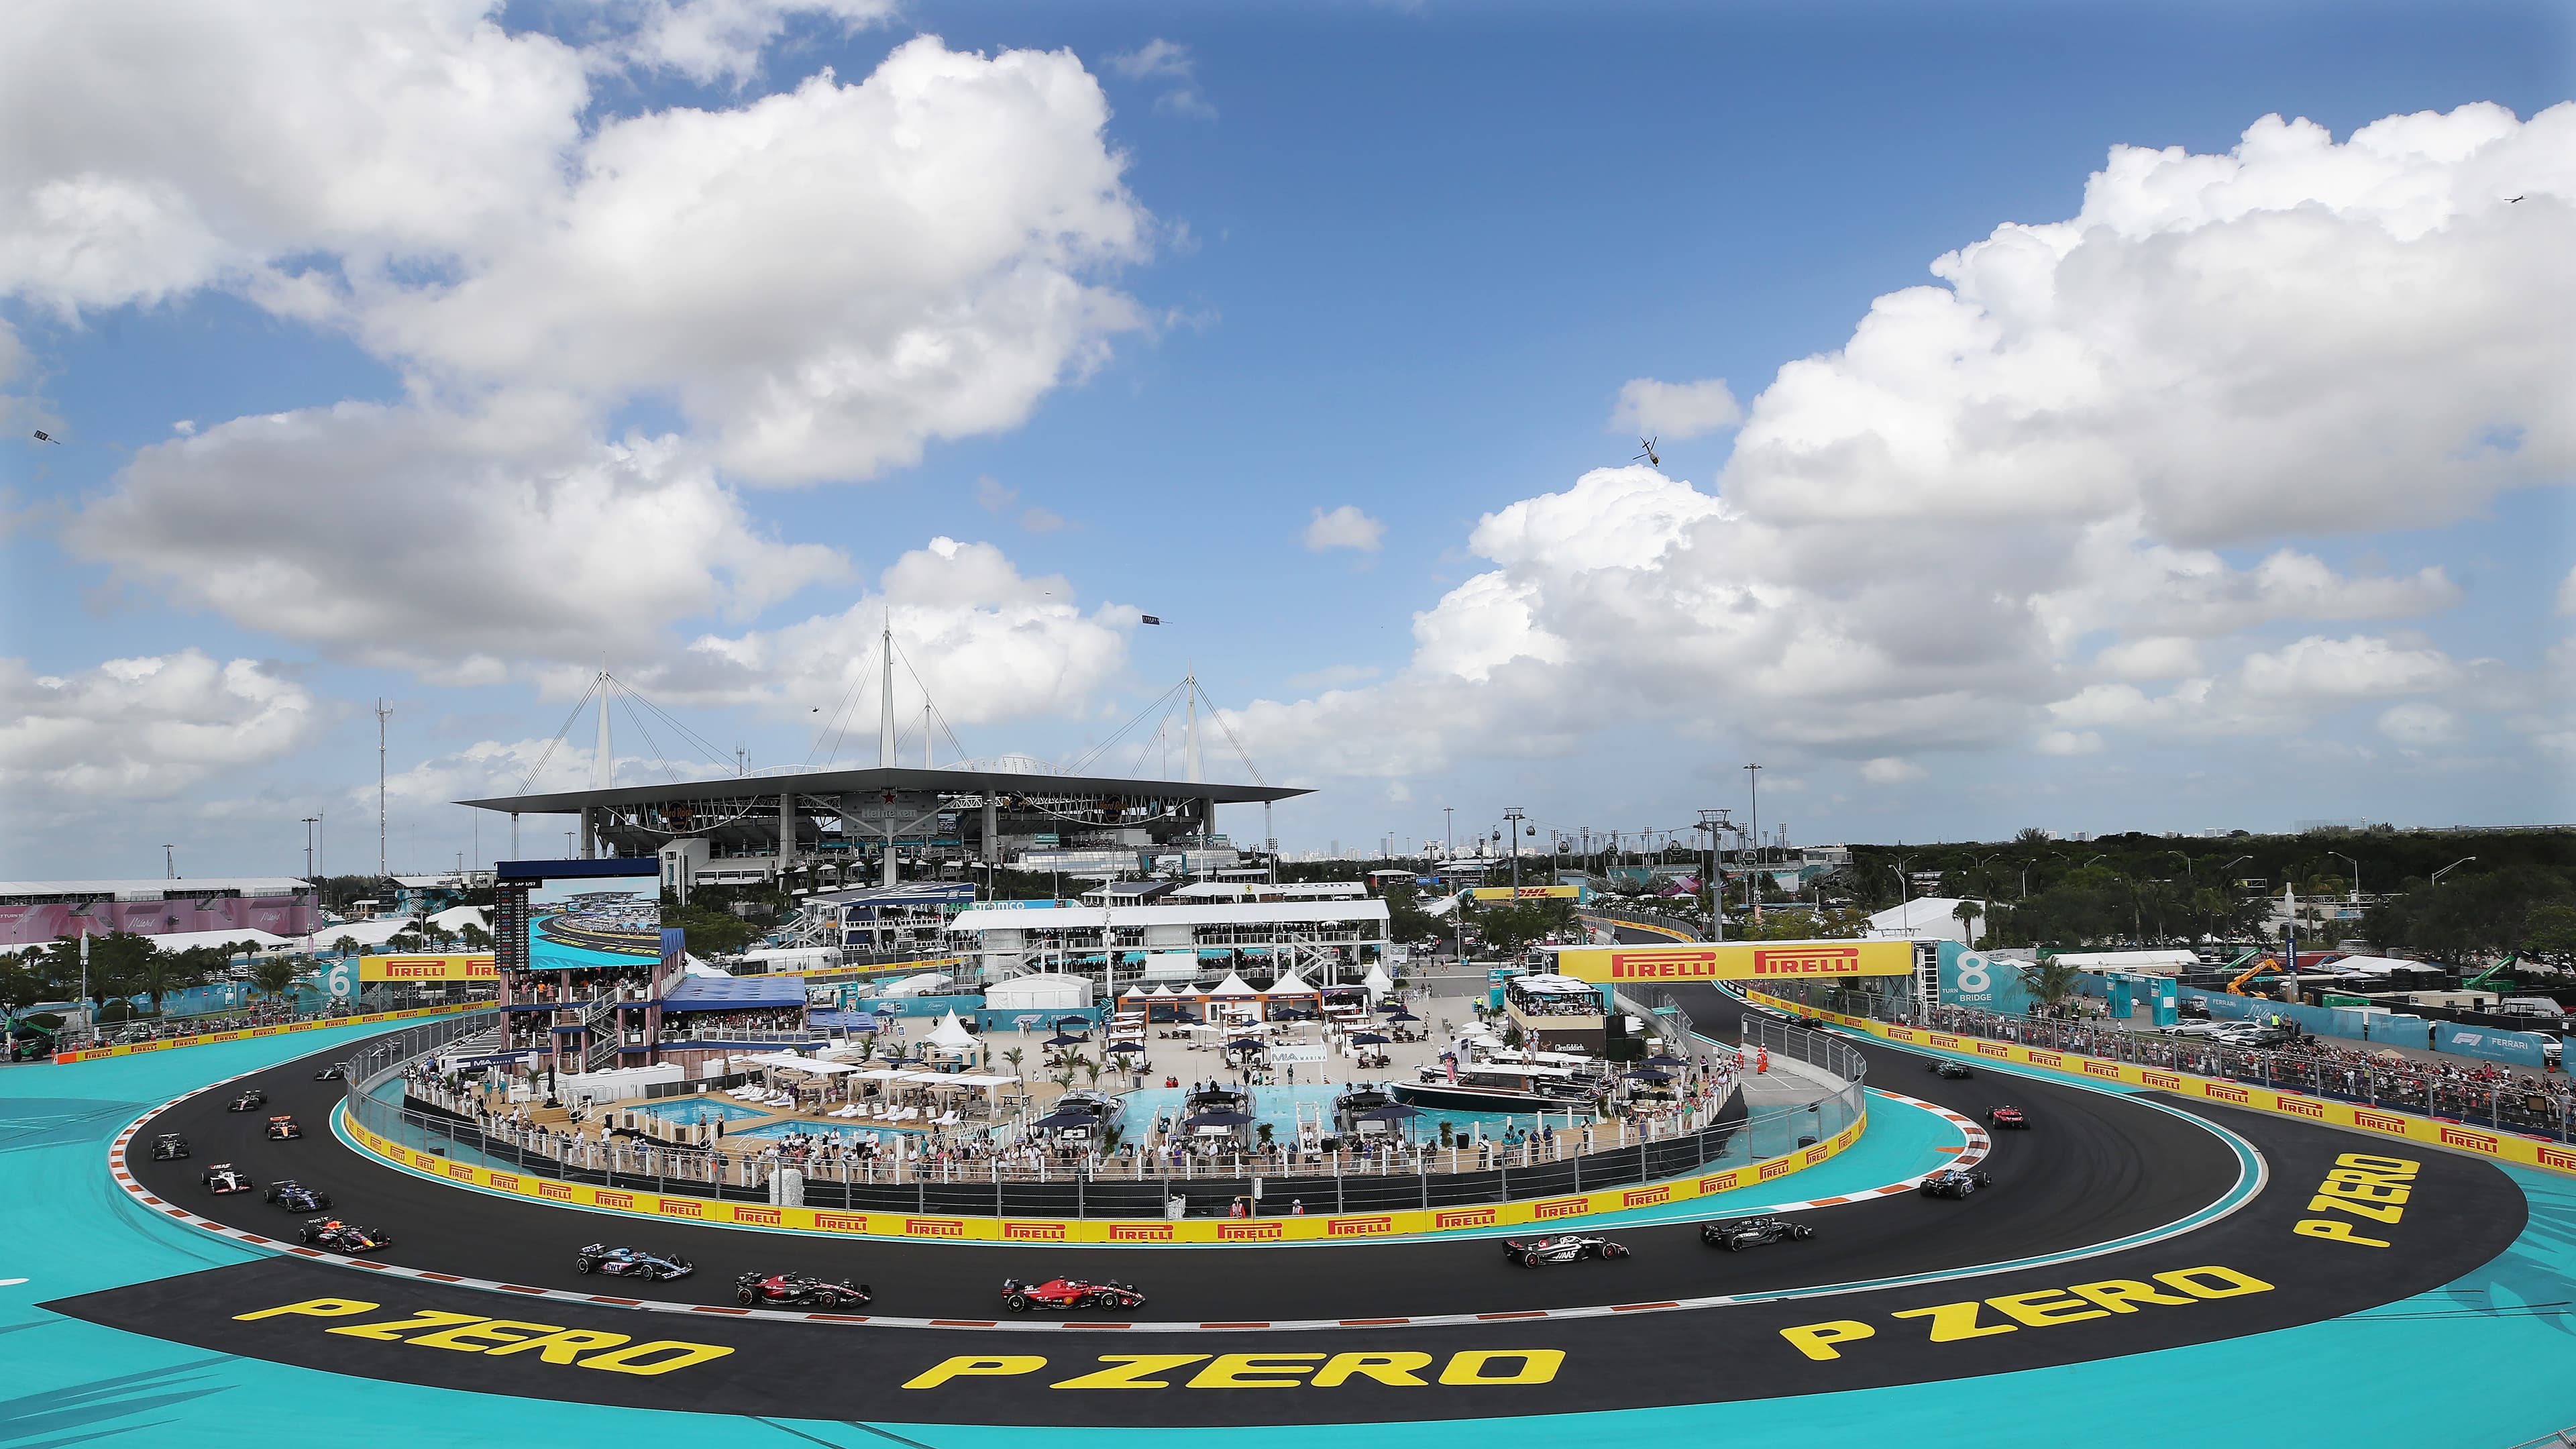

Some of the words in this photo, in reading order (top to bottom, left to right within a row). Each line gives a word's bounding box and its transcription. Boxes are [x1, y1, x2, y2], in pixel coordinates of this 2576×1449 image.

[1515, 889, 1548, 897] DHL
[386, 961, 445, 976] PIRELLI
[466, 960, 500, 976] PIRE
[1612, 952, 1716, 977] PIRELLI
[1755, 948, 1859, 973] PIRELLI
[1956, 951, 1991, 993] 8
[329, 965, 350, 997] 6
[2212, 998, 2237, 1008] FERRARI
[325, 1019, 347, 1027] PIRELLI
[1845, 1017, 1862, 1028] PIRELLI
[213, 1032, 238, 1042] PIRELLI
[252, 1027, 276, 1037] PIRELLI
[1888, 1028, 1913, 1041] PIRELLI
[2451, 1032, 2483, 1046] F1
[130, 1042, 158, 1053] PIRELLI
[172, 1037, 199, 1047] PIRELLI
[1930, 1035, 1958, 1049] PIRELLI
[1977, 1042, 2008, 1057] PIRELLI
[2491, 1038, 2528, 1050] FERRARI
[1272, 1053, 1299, 1061] MIA
[2029, 1051, 2061, 1067] PIRELLI
[2084, 1061, 2119, 1078] PIRELLI
[2143, 1072, 2180, 1090] PIRELLI
[2205, 1083, 2249, 1104] PIRELLI
[2277, 1097, 2323, 1118] PIRELLI
[2354, 1111, 2405, 1134] PIRELLI
[1839, 1131, 1852, 1149] PIRELLI
[2440, 1127, 2498, 1153] PIRELLI
[390, 1146, 405, 1161] PIRELLI
[1806, 1145, 1827, 1165] PIRELLI
[2537, 1147, 2576, 1171] PIRE
[417, 1155, 435, 1170] PIRELLI
[1760, 1160, 1788, 1179] PIRELLI
[449, 1164, 473, 1181] PIRELLI
[491, 1173, 519, 1191] PIRELLI
[539, 1182, 572, 1199] PIRELLI
[1699, 1173, 1737, 1194] PIRELLI
[2308, 1153, 2420, 1224] ZERO
[595, 1191, 633, 1208] PIRELLI
[1623, 1186, 1670, 1207] PIRELLI
[659, 1199, 702, 1217] PIRELLI
[734, 1207, 782, 1224] PIRELLI
[1534, 1198, 1589, 1218] PIRELLI
[815, 1214, 867, 1230] PIRELLI
[1328, 1217, 1391, 1235] PIRELLI
[1436, 1209, 1496, 1228] PIRELLI
[906, 1219, 963, 1236] PIRELLI
[1005, 1223, 1065, 1239] PIRELLI
[1110, 1224, 1173, 1240] PIRELLI
[1218, 1223, 1283, 1239] PIRELLI
[2294, 1219, 2390, 1248] P
[1552, 1250, 1578, 1260] HAAS
[606, 1263, 621, 1271] BWT
[1780, 1320, 1875, 1360] P
[1893, 1265, 2275, 1342] ZERO
[233, 1299, 379, 1321] P
[326, 1310, 735, 1375] ZERO
[902, 1355, 1047, 1389] P
[1050, 1349, 1566, 1389] ZERO
